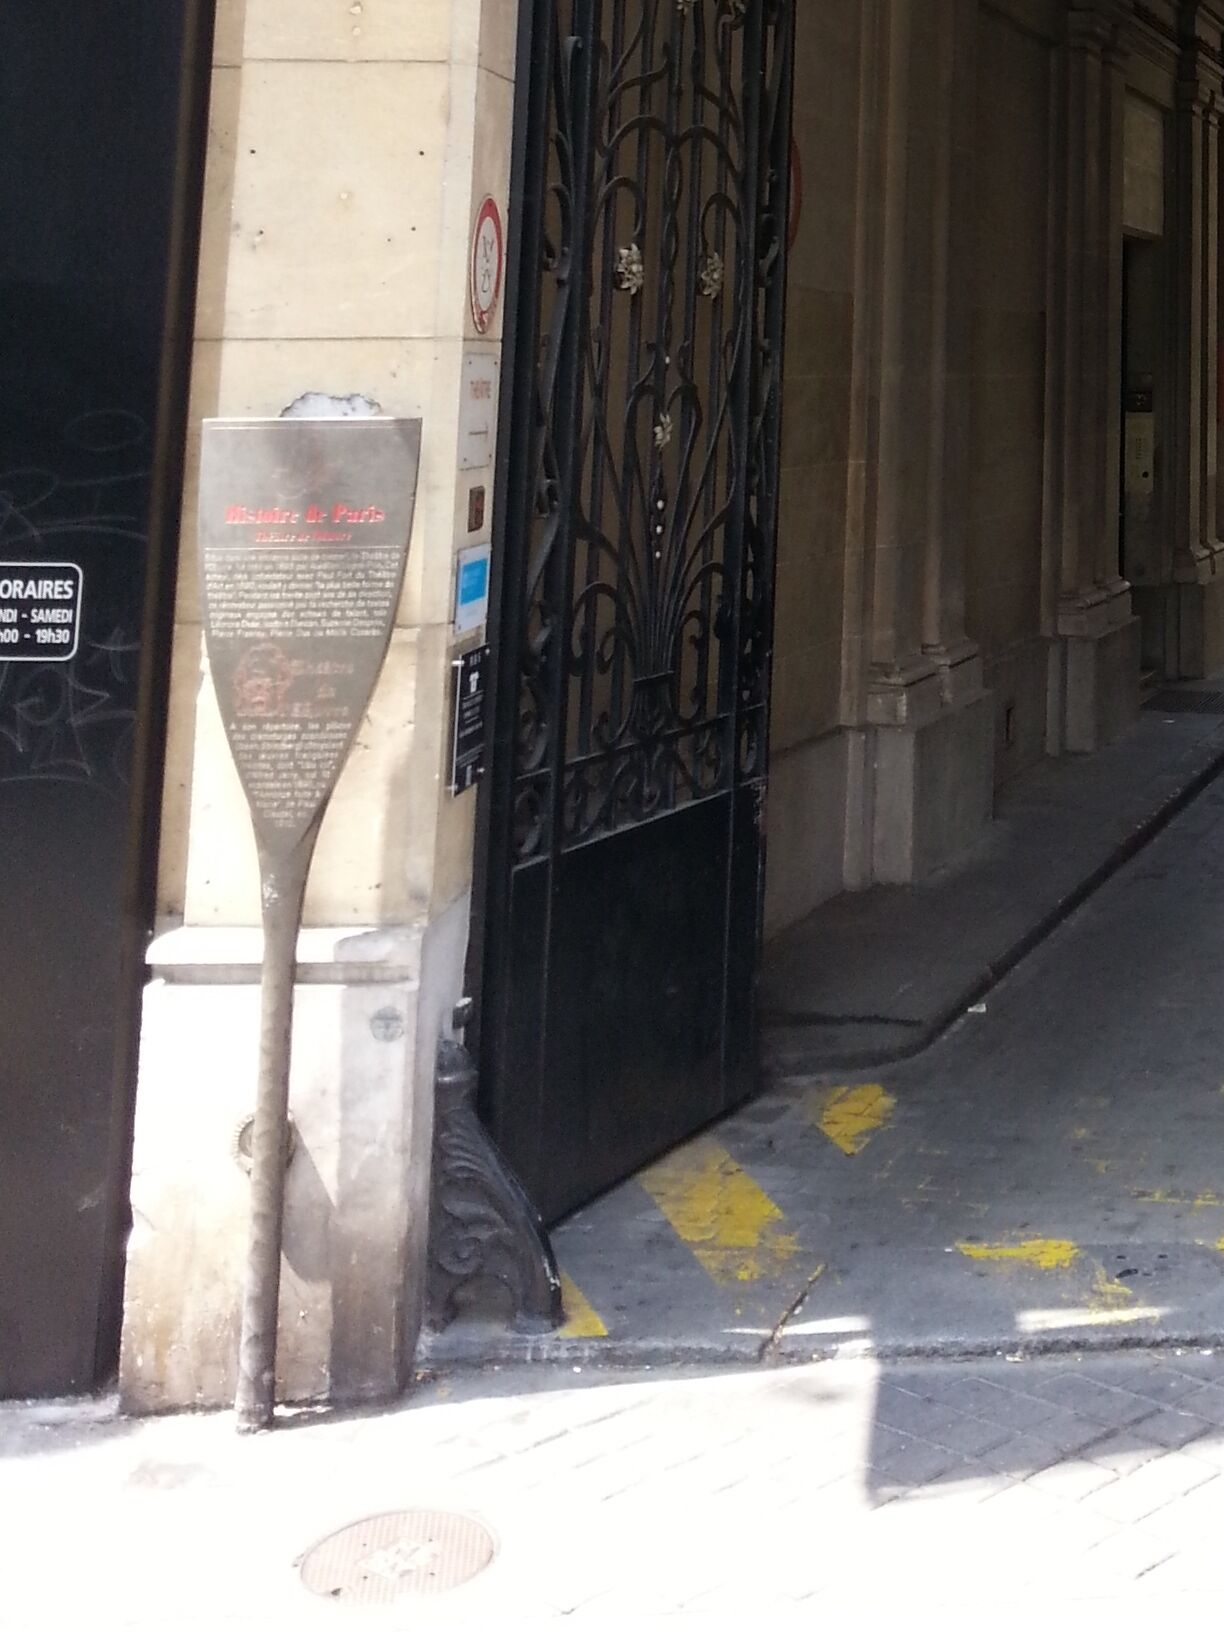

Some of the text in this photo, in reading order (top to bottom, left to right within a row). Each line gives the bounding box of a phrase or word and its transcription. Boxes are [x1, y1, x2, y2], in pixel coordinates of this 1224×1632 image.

[0, 579, 74, 599] ORAIRES
[30, 608, 73, 623] SAMEDI
[36, 628, 70, 643] 19h30
